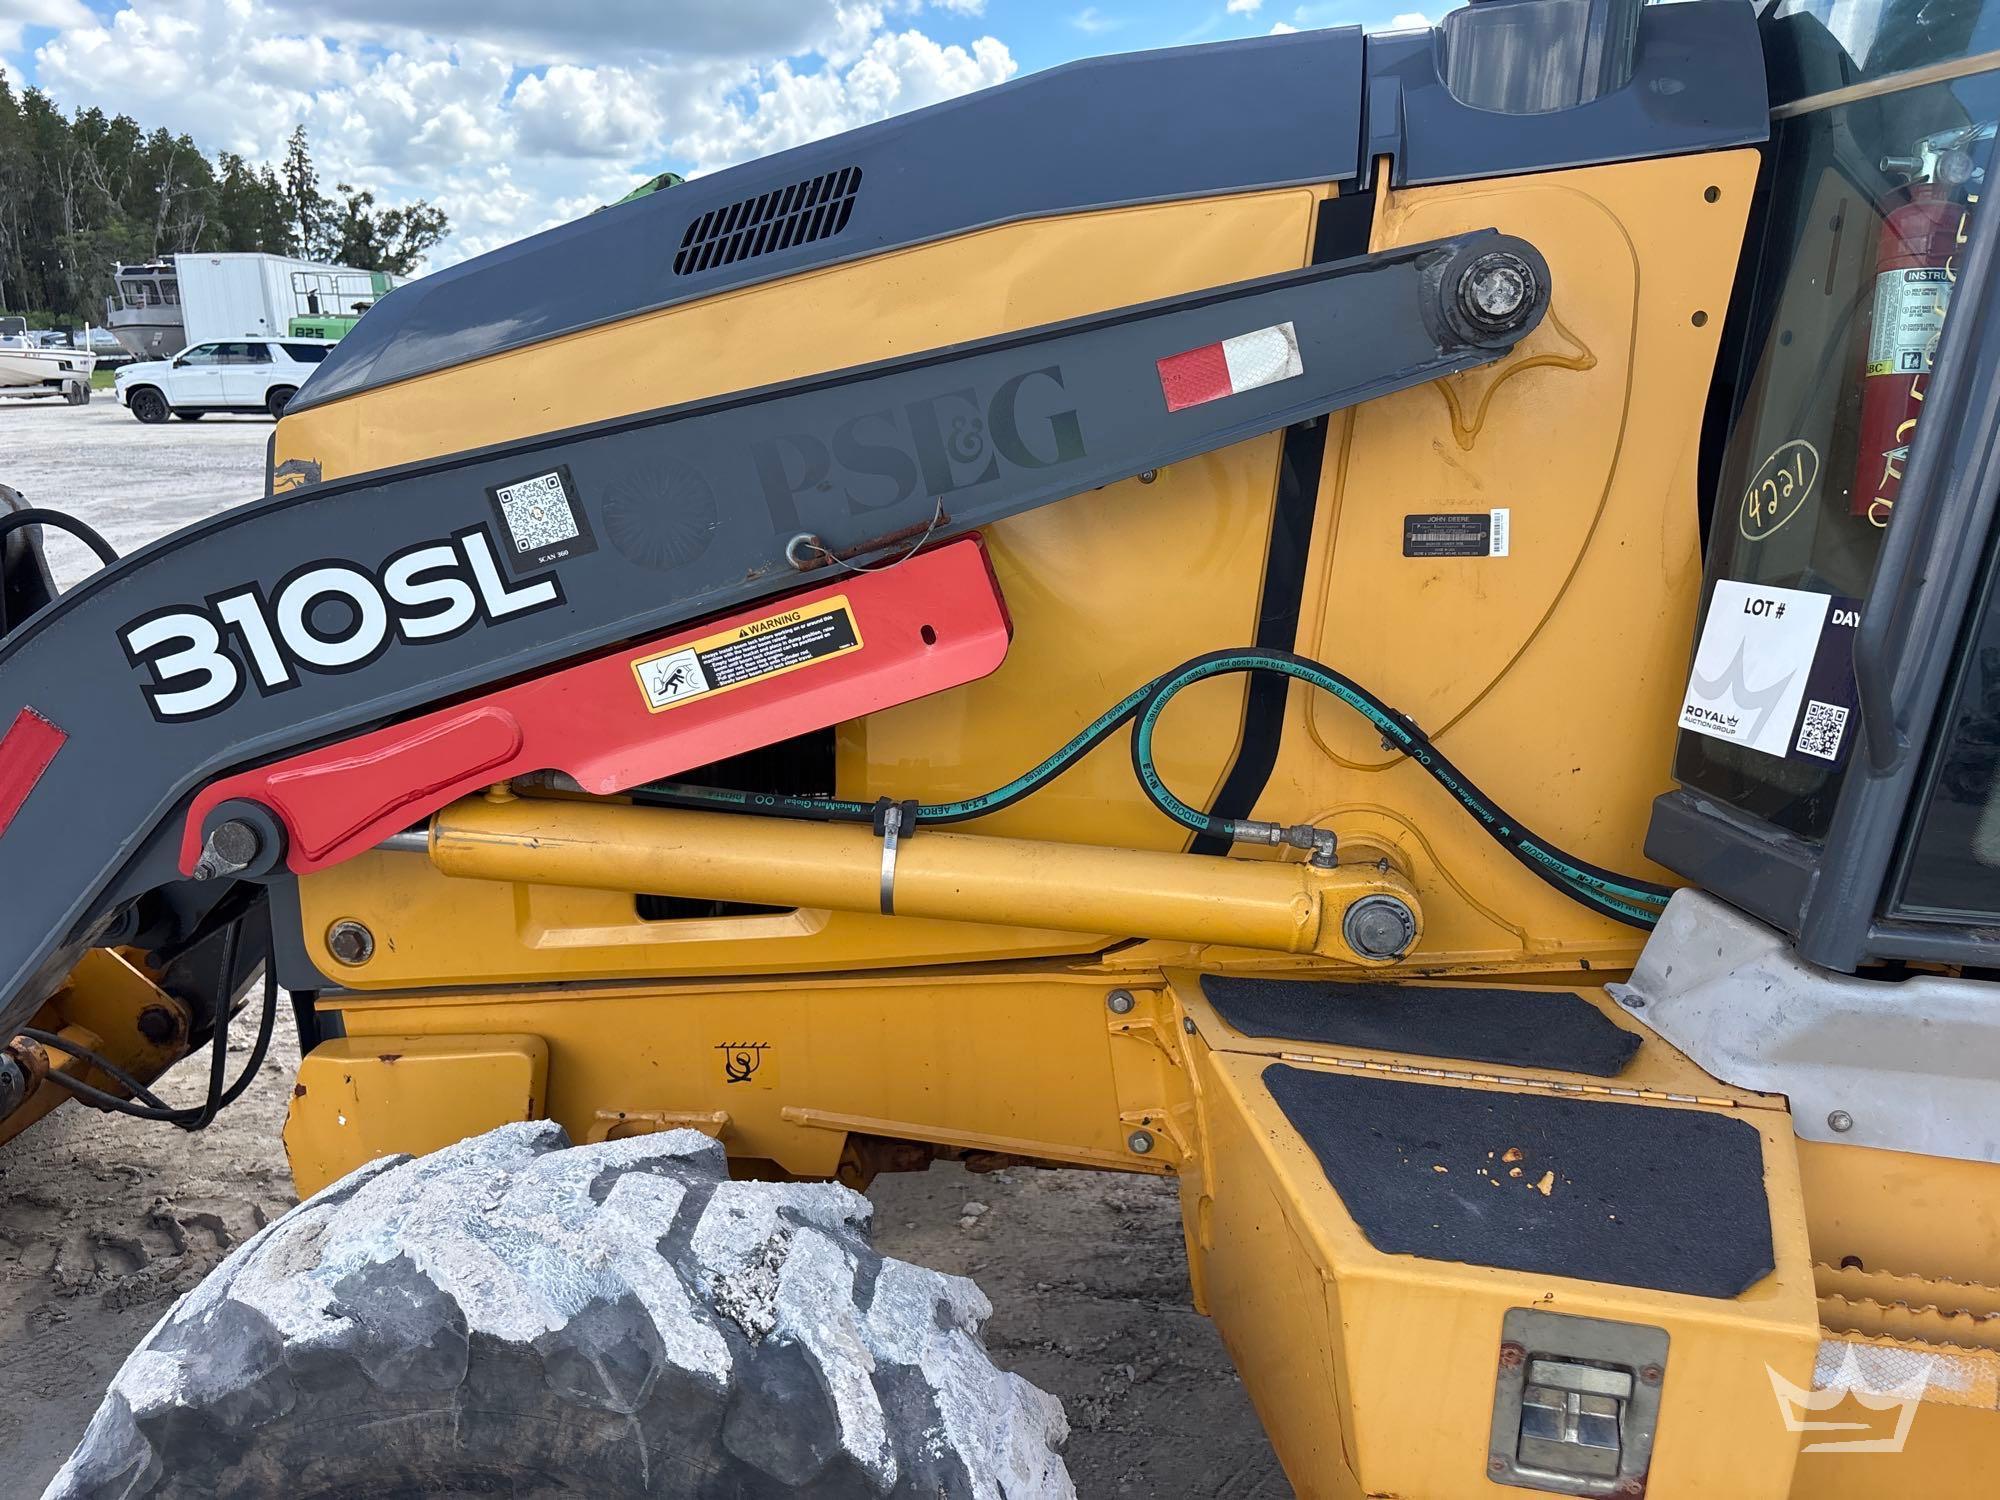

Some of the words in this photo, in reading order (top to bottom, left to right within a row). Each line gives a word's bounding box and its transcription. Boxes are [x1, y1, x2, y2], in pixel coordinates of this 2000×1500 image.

[1909, 271, 1957, 280] INSTRU
[295, 328, 324, 338] 825
[1867, 364, 1883, 374] BC
[1748, 452, 1804, 527] 4221
[538, 552, 556, 564] SCAN
[557, 549, 569, 558] 360
[1744, 598, 1774, 617] LOT
[1775, 602, 1786, 619] #
[121, 526, 562, 719] 310SL
[748, 612, 801, 635] WARNING
[1832, 609, 1860, 627] DAY
[1215, 660, 1230, 670] psi)
[1232, 659, 1254, 667] (4500
[1272, 662, 1286, 670] 310
[1293, 666, 1315, 680] DN12
[1345, 692, 1360, 704] mm
[1686, 705, 1725, 724] ROYAL
[1684, 716, 1712, 728] AUCTION
[1712, 724, 1736, 734] GROUP
[1435, 768, 1457, 789] Global
[784, 799, 812, 809] Global
[814, 801, 862, 813] MatchMate
[917, 806, 950, 816] AEROQ
[1160, 794, 1208, 827] AEROQUIP
[1458, 788, 1495, 823] MatchMate
[1521, 845, 1568, 873] AEROQUIP
